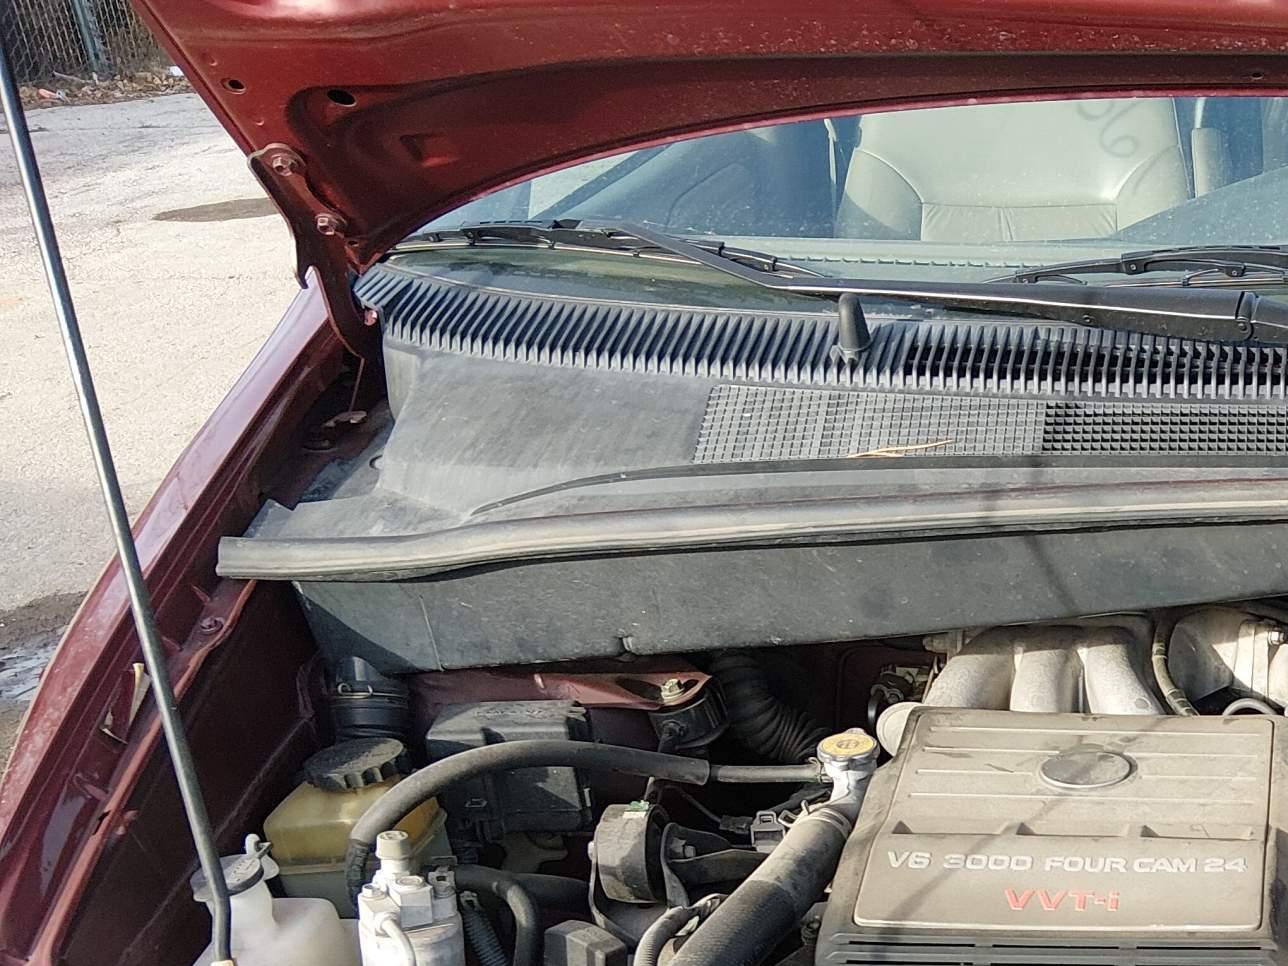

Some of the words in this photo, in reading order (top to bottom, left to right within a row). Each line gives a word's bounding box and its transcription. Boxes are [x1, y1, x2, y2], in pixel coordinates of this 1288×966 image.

[887, 851, 931, 869] V6
[943, 854, 1033, 871] 3000
[1044, 856, 1128, 873] FOUR
[1133, 857, 1200, 873] CAM
[1203, 858, 1248, 873] 24
[1004, 888, 1121, 912] VVT-i
